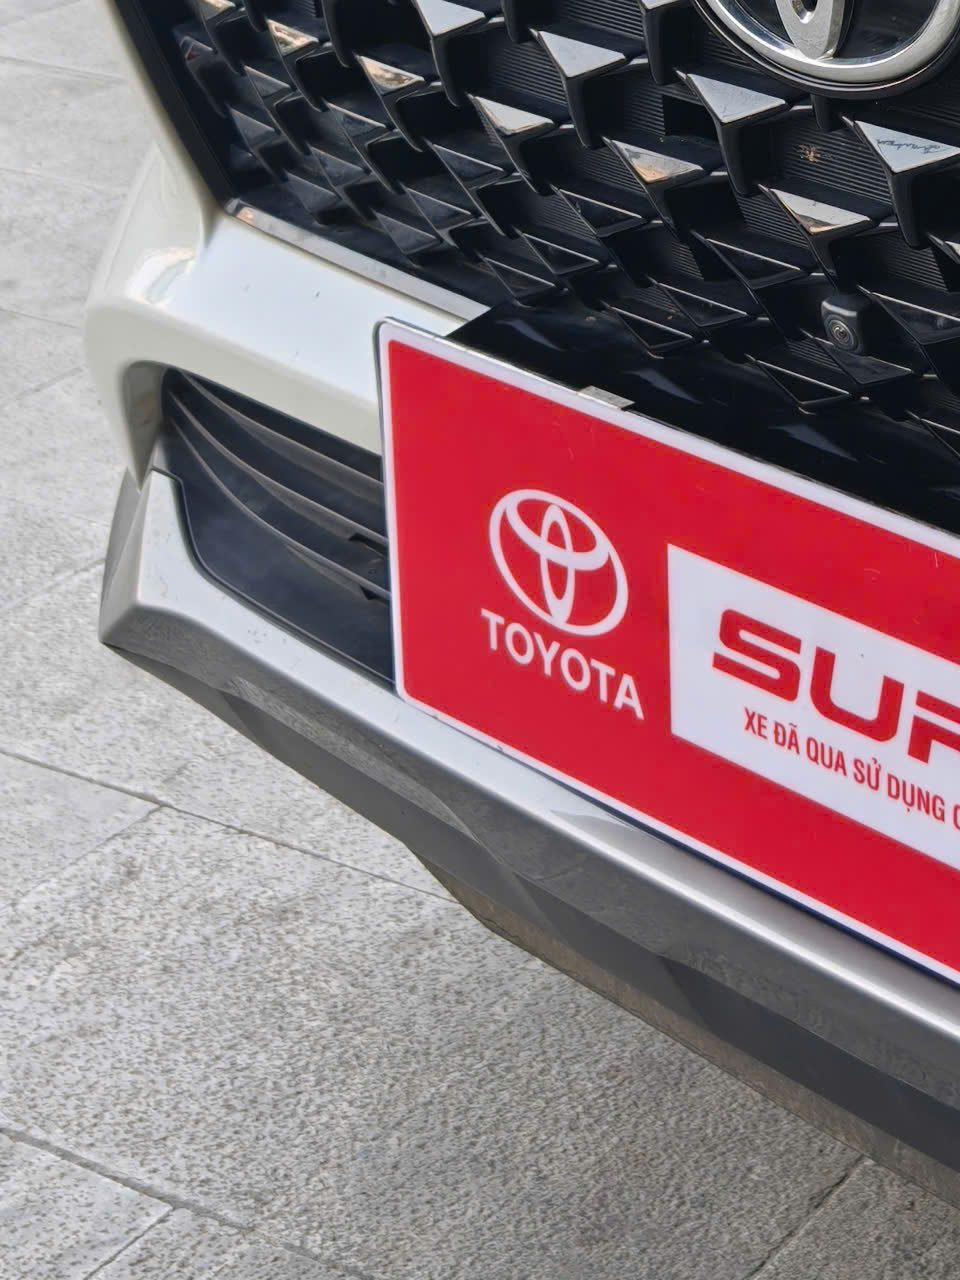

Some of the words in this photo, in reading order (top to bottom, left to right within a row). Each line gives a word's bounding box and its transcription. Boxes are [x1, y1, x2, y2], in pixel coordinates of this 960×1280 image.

[480, 608, 644, 720] TOYOTA
[744, 707, 768, 740] XE
[773, 721, 800, 755] ĐÃ
[806, 736, 847, 777] QUA
[853, 757, 882, 792] SỬ
[887, 773, 945, 823] DỤNG
